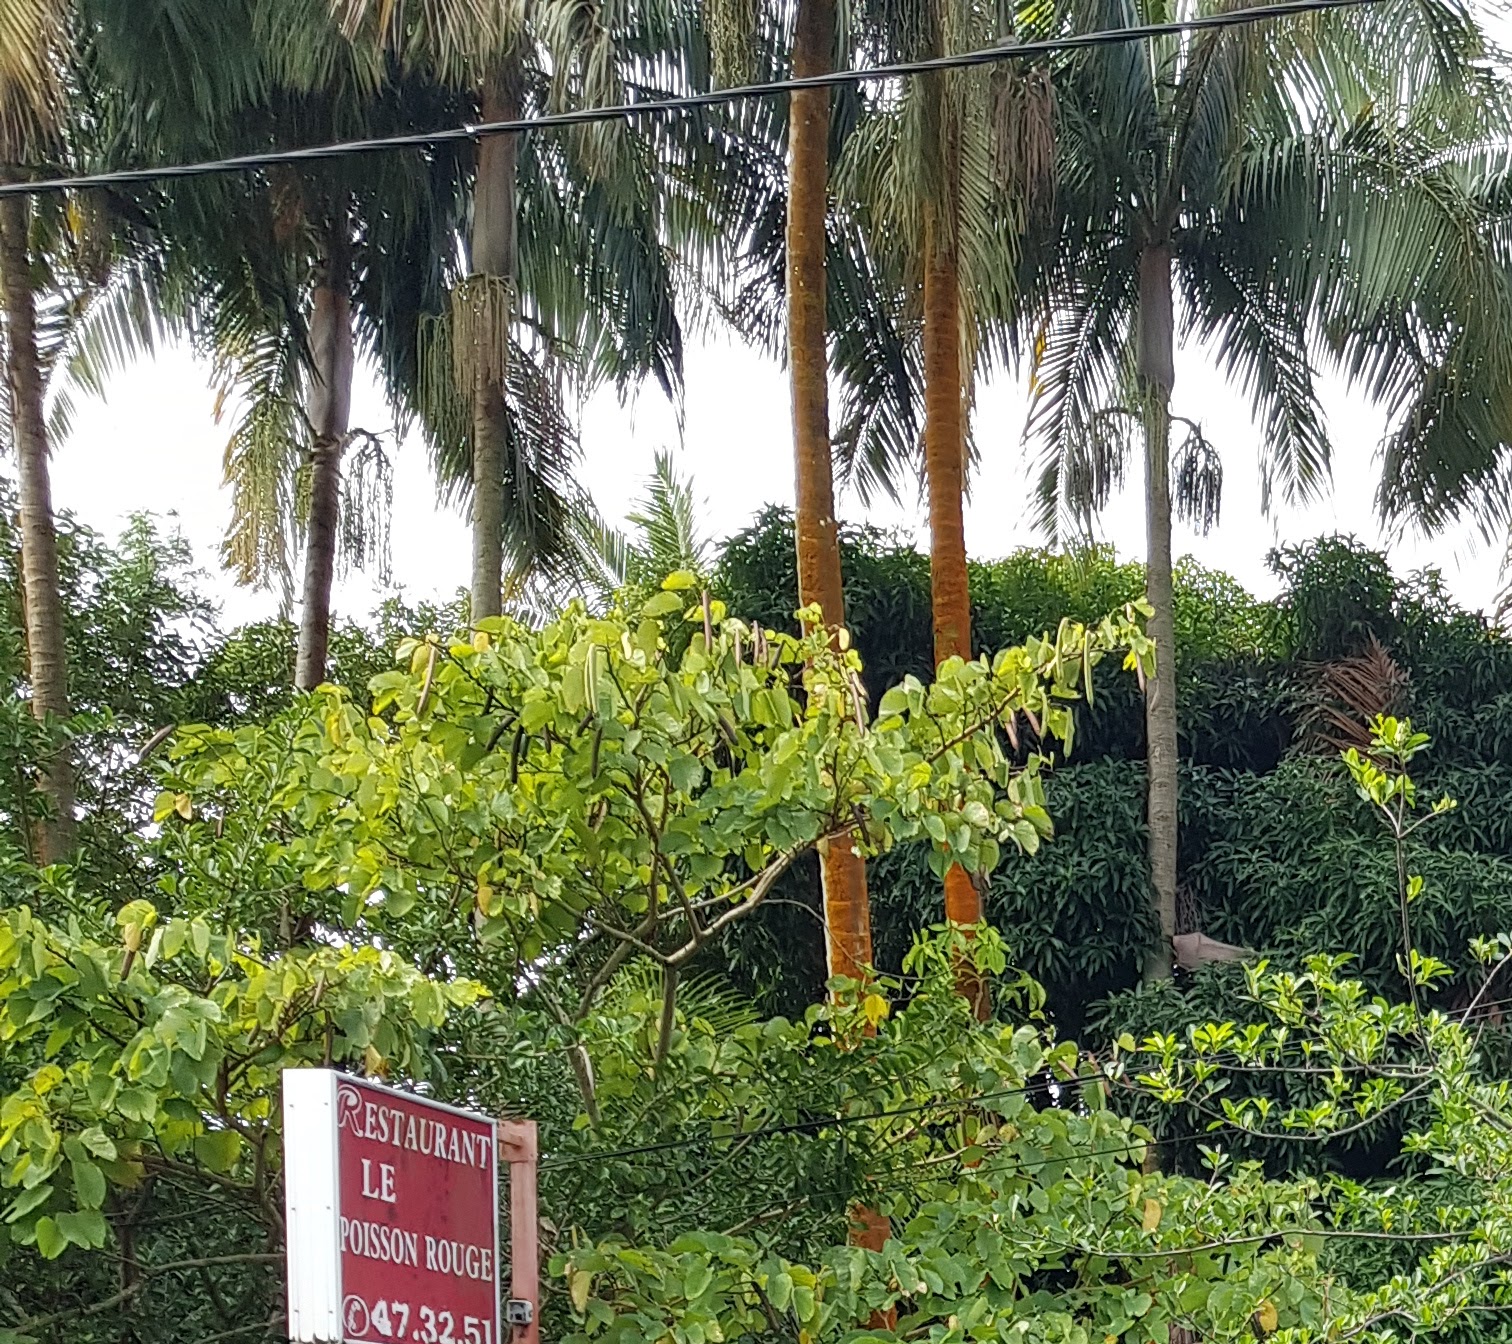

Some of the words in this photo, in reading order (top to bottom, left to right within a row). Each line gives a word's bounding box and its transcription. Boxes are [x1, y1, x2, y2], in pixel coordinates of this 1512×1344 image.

[337, 1084, 491, 1170] RESTAURANT
[361, 1158, 397, 1204] LE
[339, 1216, 419, 1268] POISSON
[425, 1235, 493, 1282] ROUGE
